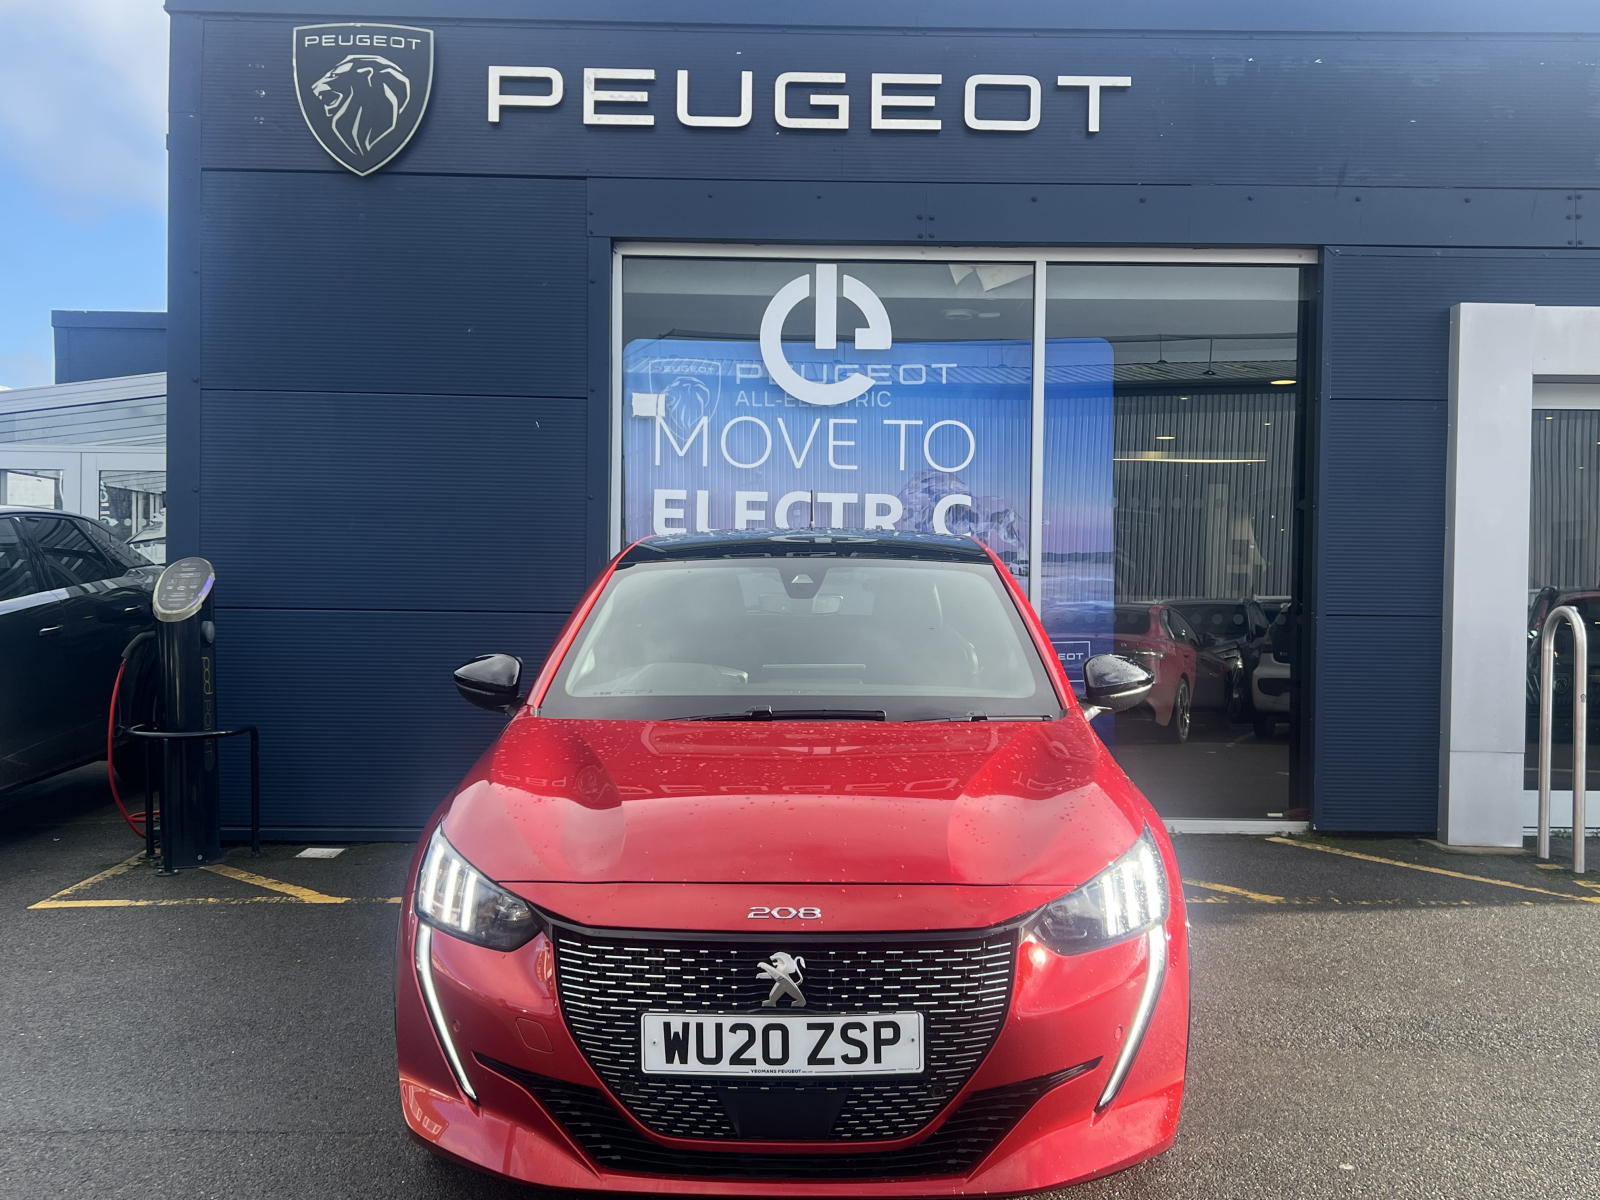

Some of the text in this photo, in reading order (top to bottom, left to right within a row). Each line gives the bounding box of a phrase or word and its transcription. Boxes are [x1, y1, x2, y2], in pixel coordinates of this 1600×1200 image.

[305, 34, 421, 50] PEUGEOT
[487, 64, 1133, 133] PEUGEOT
[736, 363, 957, 385] PUGEOT
[655, 416, 976, 473] MOVE TO
[201, 656, 213, 695] pod
[747, 906, 822, 919] 208
[663, 1020, 901, 1066] WU20 ZSP
